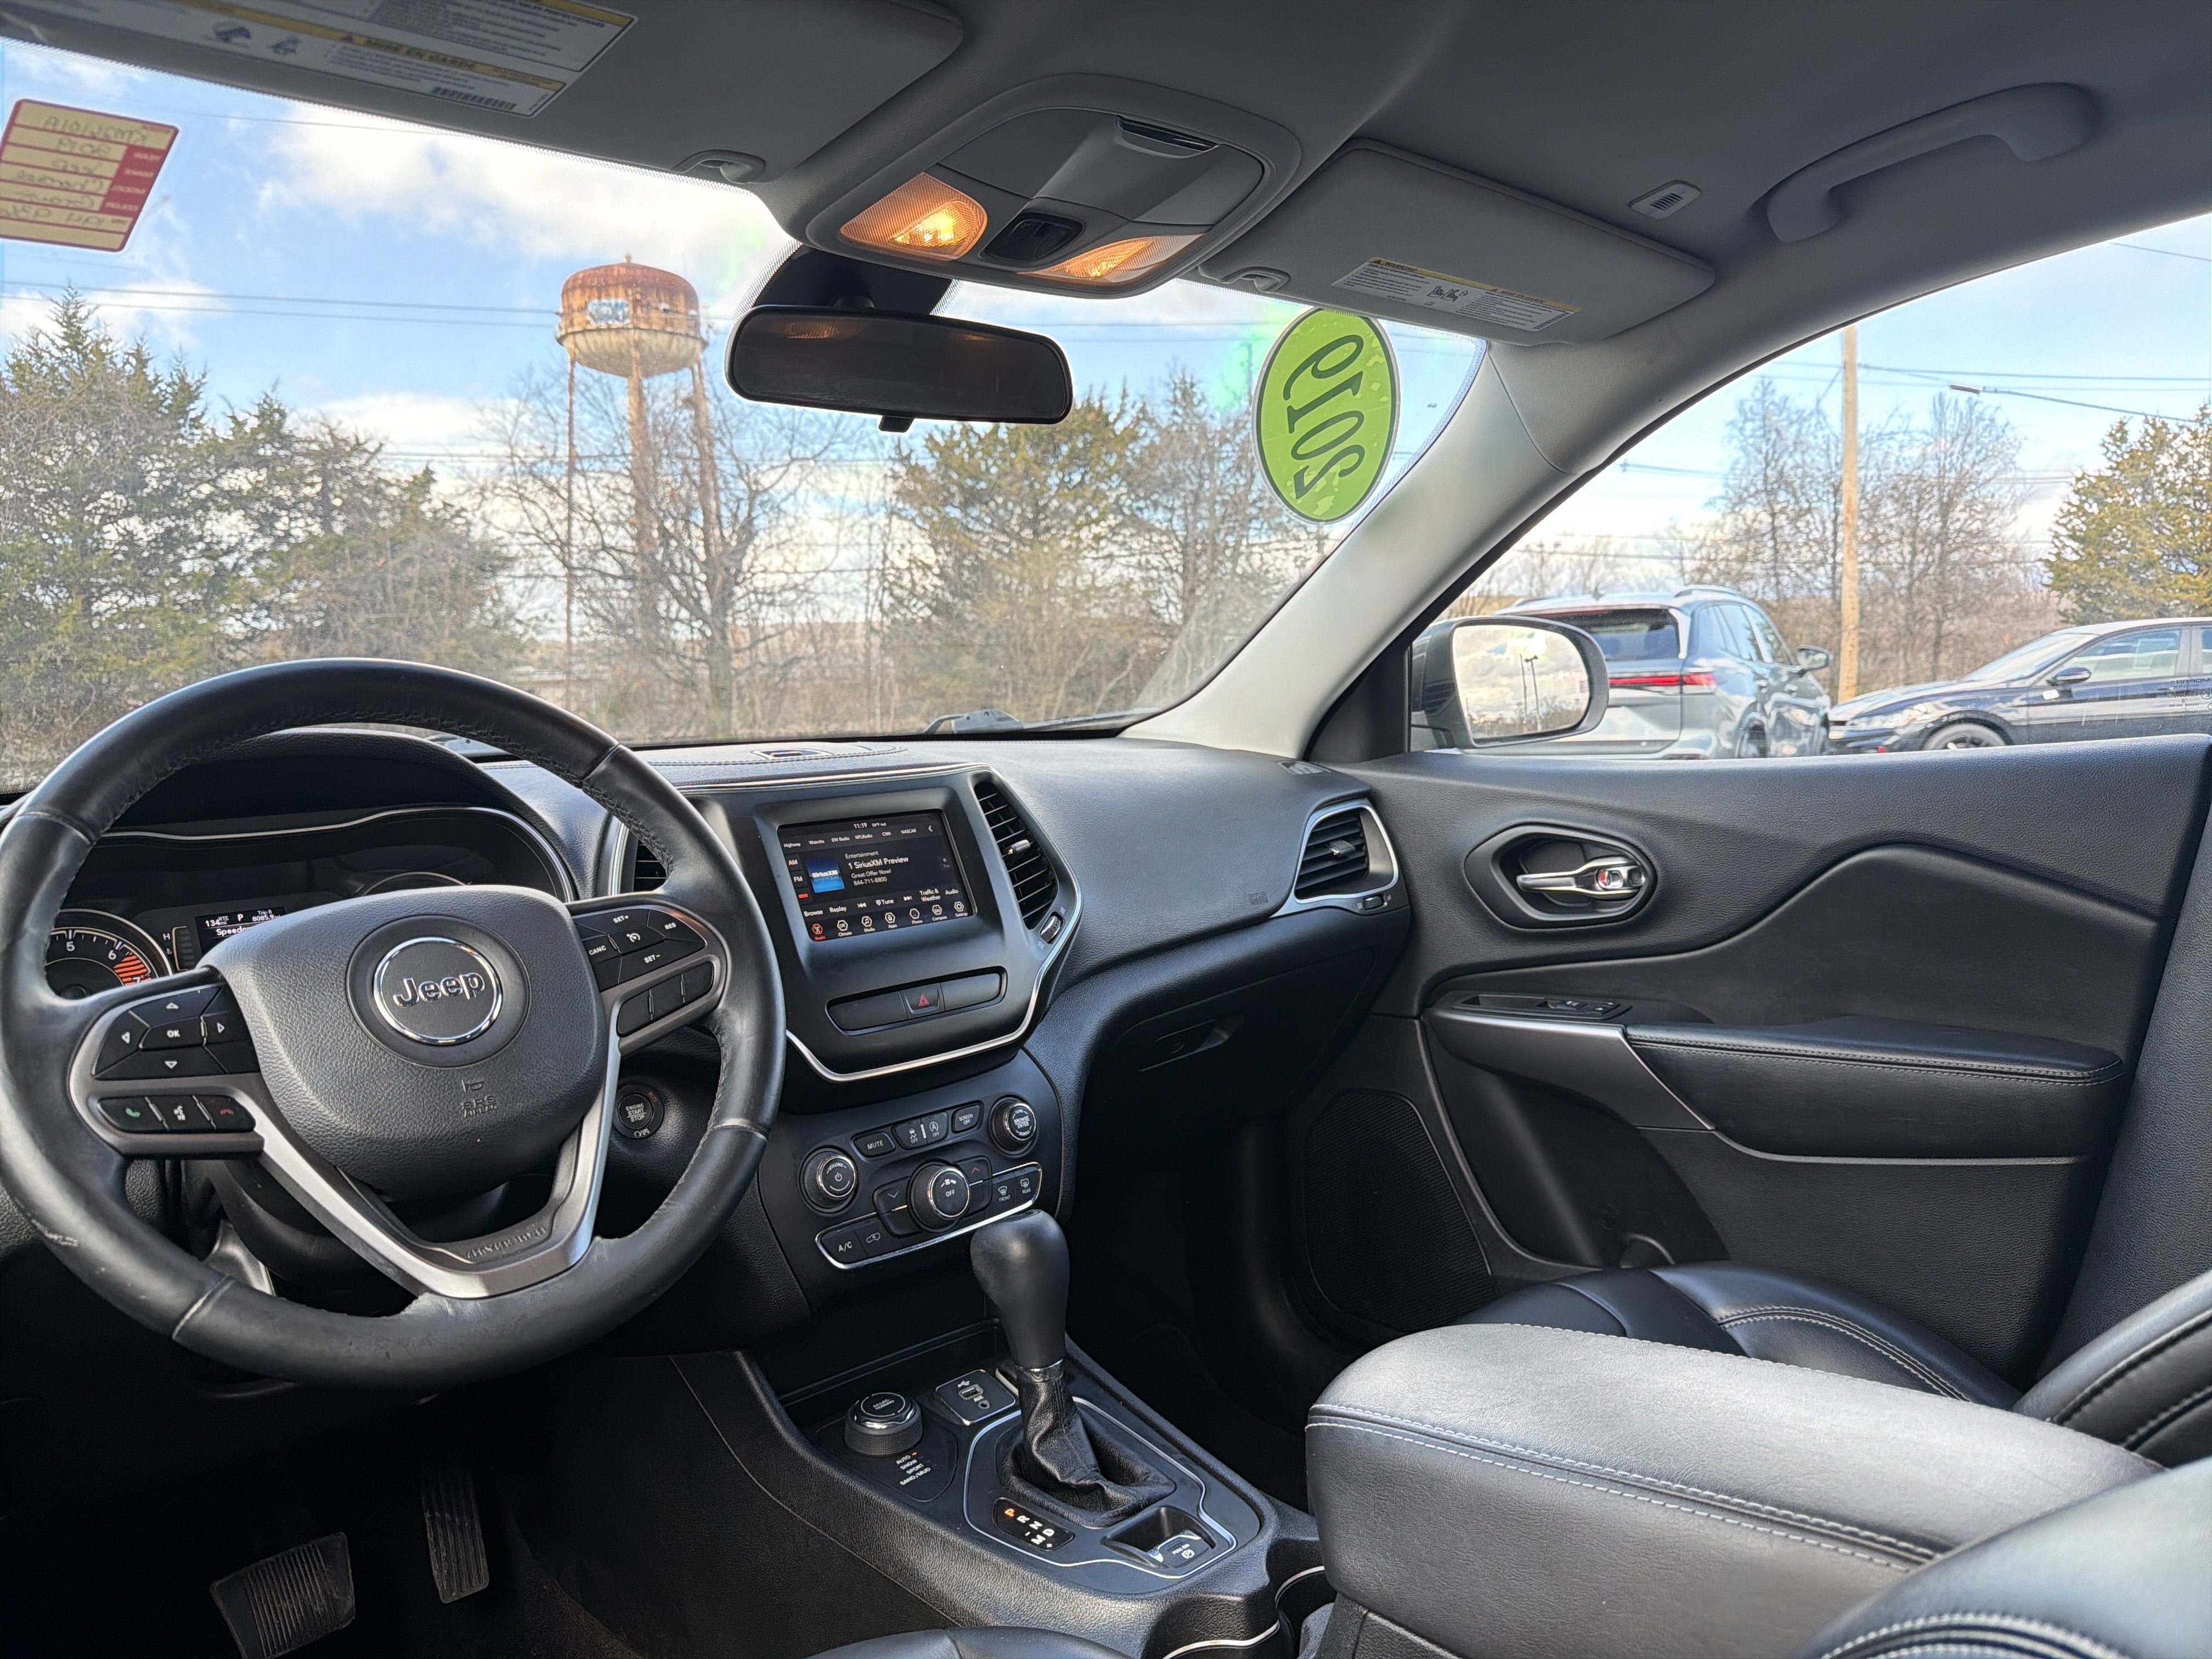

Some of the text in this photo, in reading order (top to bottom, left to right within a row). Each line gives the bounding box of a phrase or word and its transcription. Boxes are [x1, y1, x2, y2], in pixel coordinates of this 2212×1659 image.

[845, 851, 879, 859] Entertainment
[853, 858, 883, 869] SiriusXM
[884, 856, 909, 867] Preview
[812, 870, 838, 878] SiriusXM
[237, 913, 244, 922] P
[664, 922, 676, 930] RES
[163, 932, 171, 940] H
[66, 941, 75, 952] 5
[589, 945, 607, 956] CANC
[108, 950, 117, 961] 6
[392, 972, 486, 1008] Jeep
[167, 1029, 180, 1038] OK
[625, 1103, 645, 1111] ENGINE
[628, 1108, 645, 1116] START
[630, 1114, 645, 1122] STOP
[959, 1113, 974, 1121] SCREEN
[1014, 1115, 1030, 1124] BROWSE
[867, 1140, 884, 1150] MUTE
[828, 1162, 844, 1171] VOLUME
[945, 1189, 956, 1198] OFF
[838, 1241, 853, 1252] A/C
[896, 1455, 911, 1464] AUTO
[900, 1459, 918, 1470] SNOW
[906, 1463, 924, 1474] SPORT
[899, 1467, 931, 1486] SAND/MUD
[1005, 1508, 1015, 1517] P
[1017, 1515, 1030, 1523] R
[1029, 1521, 1043, 1530] N
[1042, 1528, 1055, 1537] D
[1031, 1534, 1046, 1545] M
